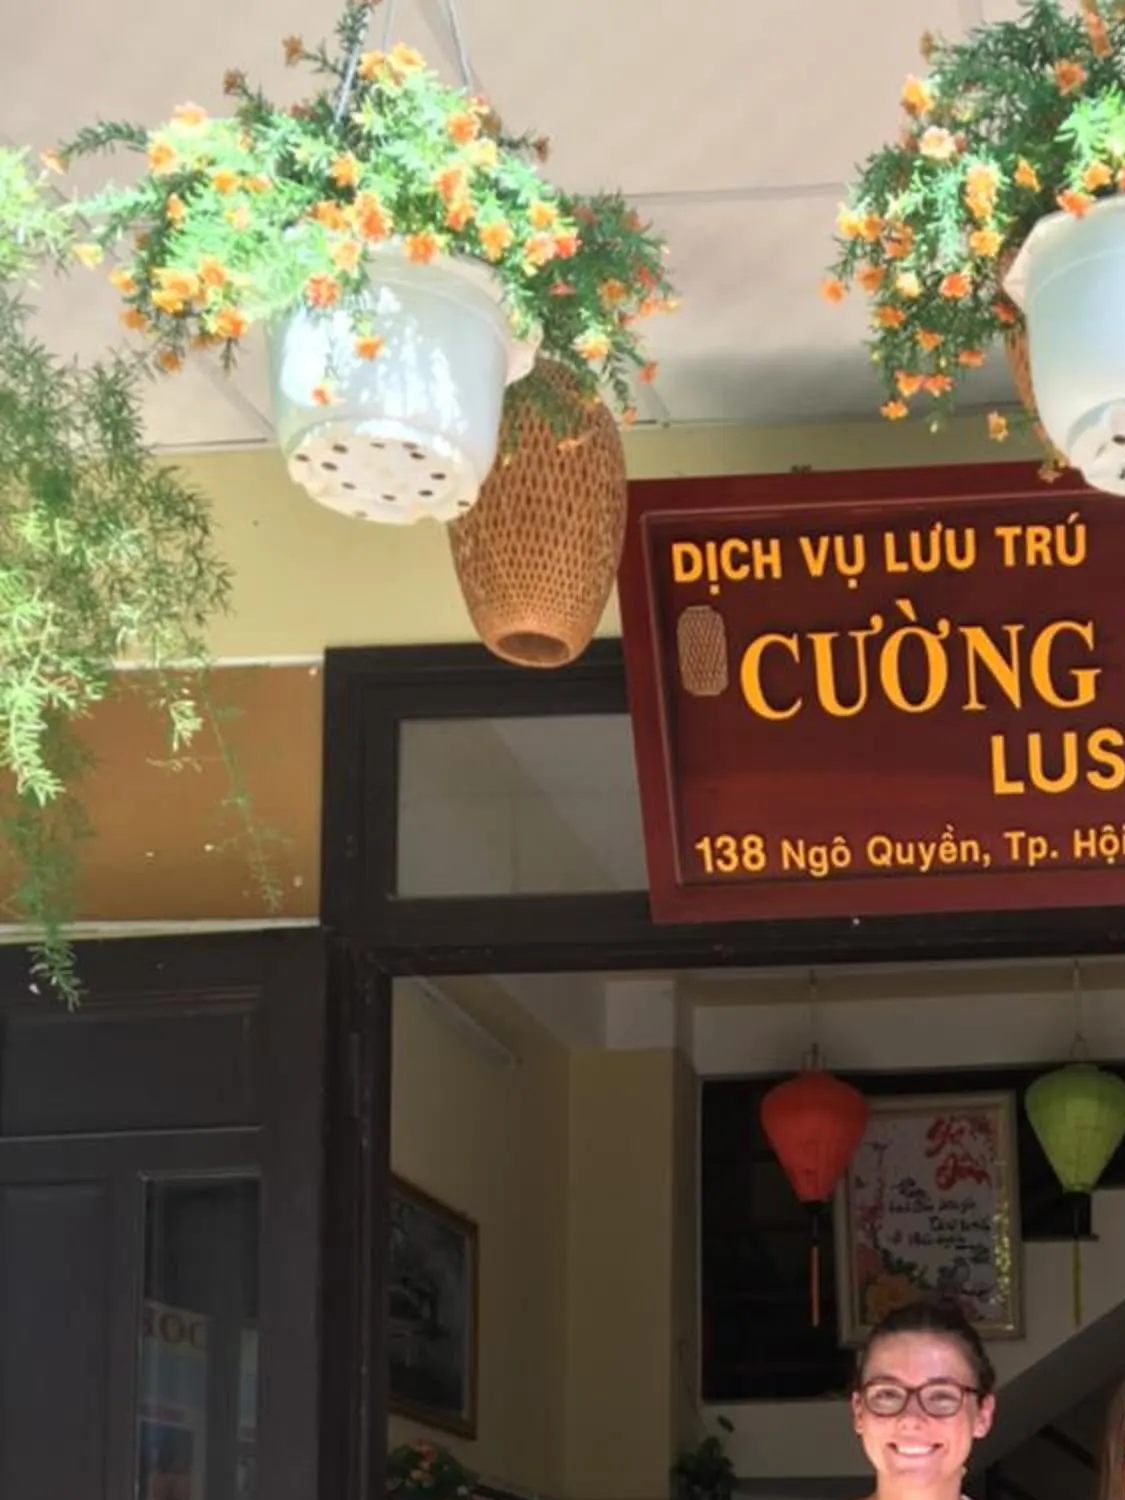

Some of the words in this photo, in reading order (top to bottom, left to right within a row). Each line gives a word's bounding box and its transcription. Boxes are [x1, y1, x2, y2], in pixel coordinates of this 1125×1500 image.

[672, 539, 782, 595] DỊCH
[799, 534, 865, 589] VỤ
[884, 522, 975, 572] LƯU
[995, 512, 1086, 567] TRÚ
[740, 599, 1101, 720] CƯỜNG
[695, 834, 766, 873] 138
[781, 836, 851, 877] Ngô
[867, 824, 991, 872] Quyền,
[1004, 831, 1058, 867] Tp.
